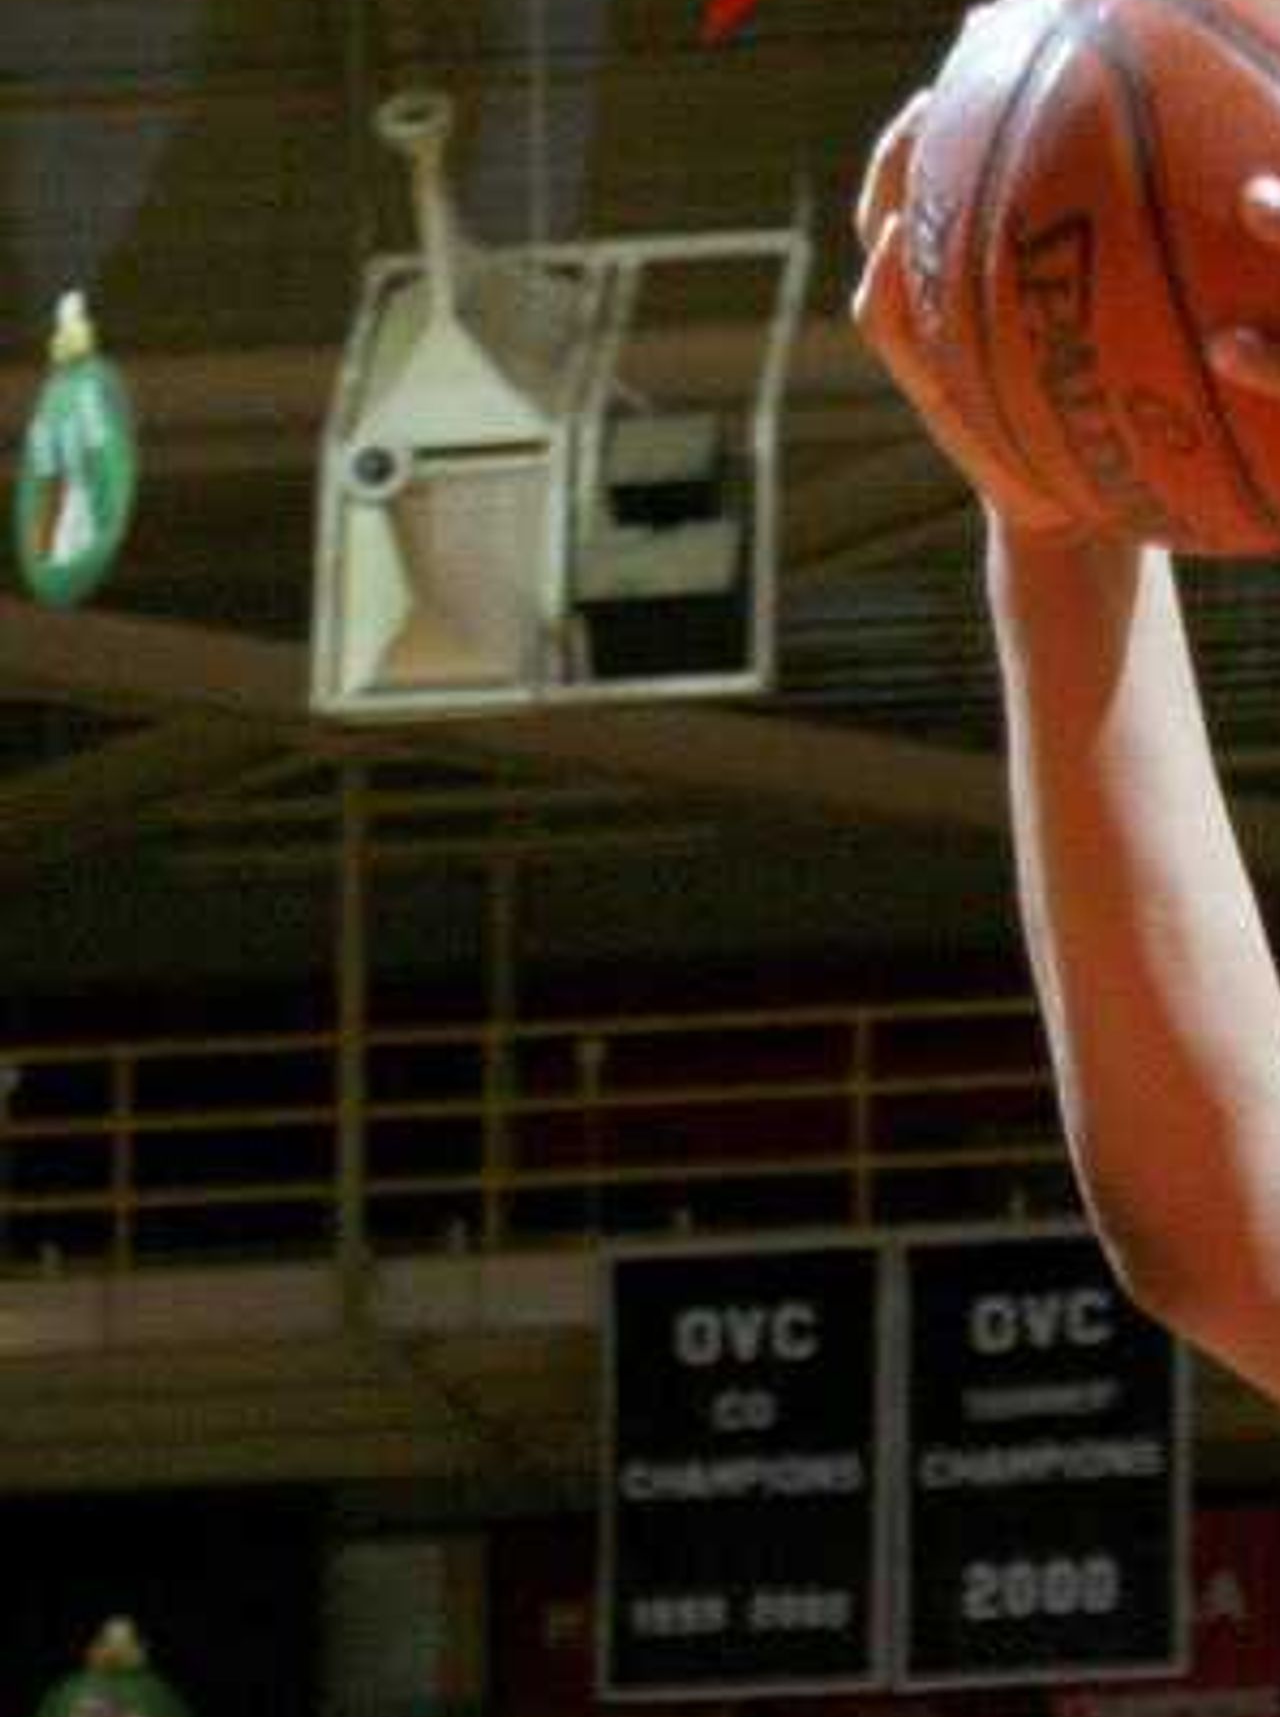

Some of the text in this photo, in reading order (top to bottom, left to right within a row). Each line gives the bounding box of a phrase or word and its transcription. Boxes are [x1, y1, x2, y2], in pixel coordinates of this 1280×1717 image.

[672, 1302, 819, 1366] OVC
[970, 1287, 1114, 1356] OVC
[620, 1449, 863, 1500] CHAMPIONS
[919, 1436, 1164, 1490] CHAMPIONS
[960, 1555, 1120, 1620] 2000
